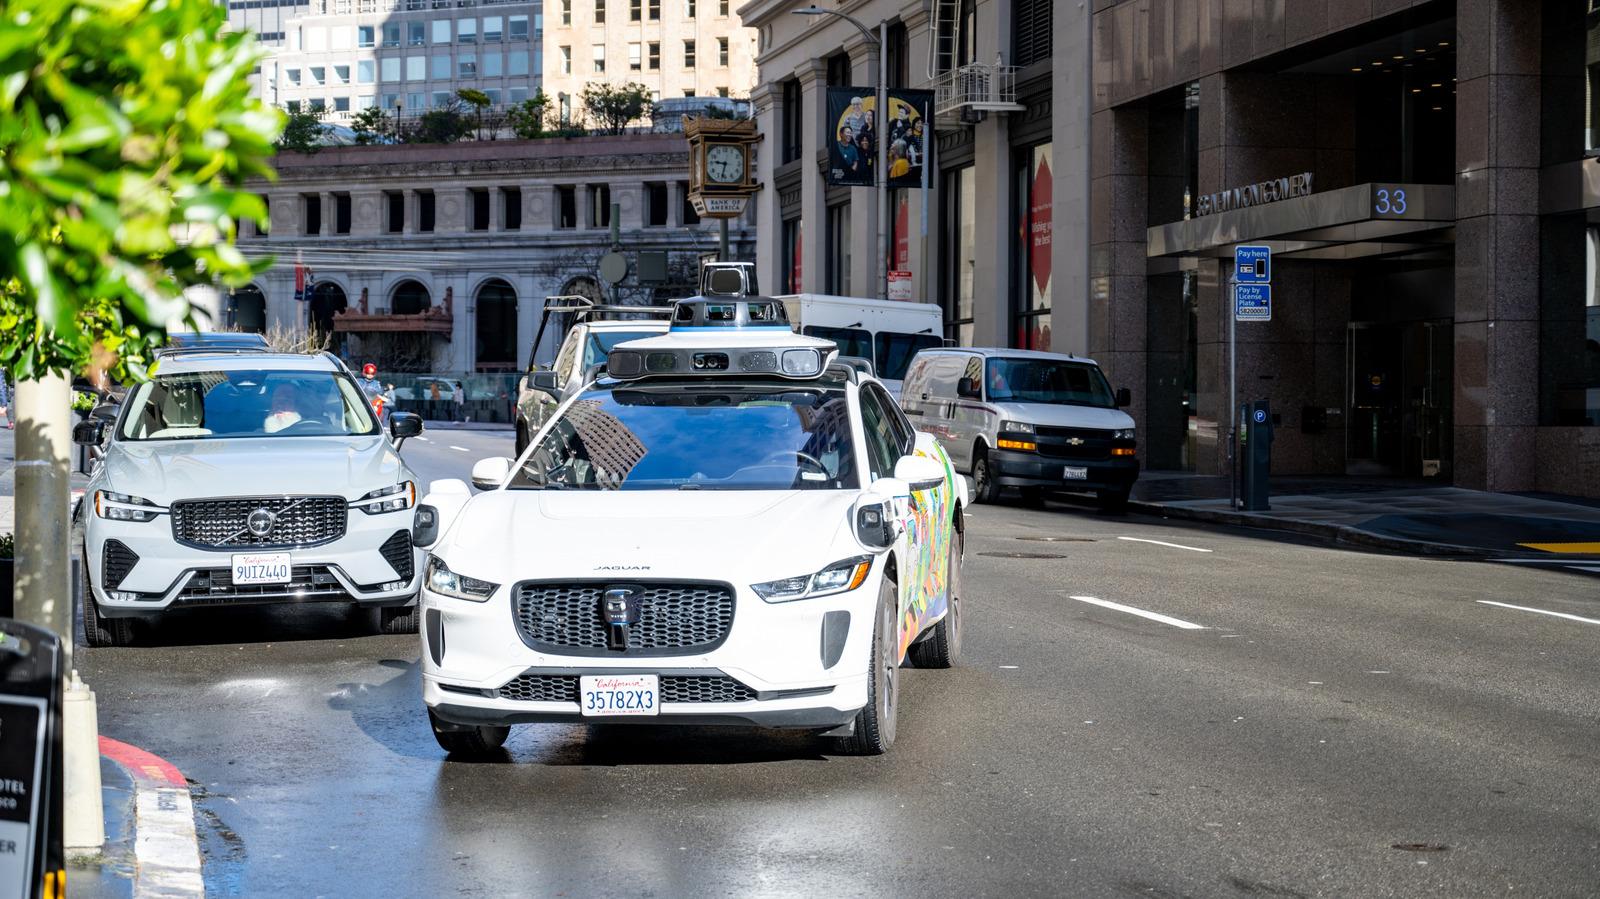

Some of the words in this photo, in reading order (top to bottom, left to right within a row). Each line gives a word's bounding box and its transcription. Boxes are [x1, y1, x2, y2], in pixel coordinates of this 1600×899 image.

[1233, 171, 1312, 208] MONTGOMERY
[1376, 189, 1407, 214] 33
[1238, 250, 1251, 259] Pay
[1239, 286, 1251, 294] Pay
[1252, 286, 1261, 294] by
[237, 565, 287, 579] 9UIZ440
[597, 679, 643, 690] California
[586, 690, 653, 709] 35782X3
